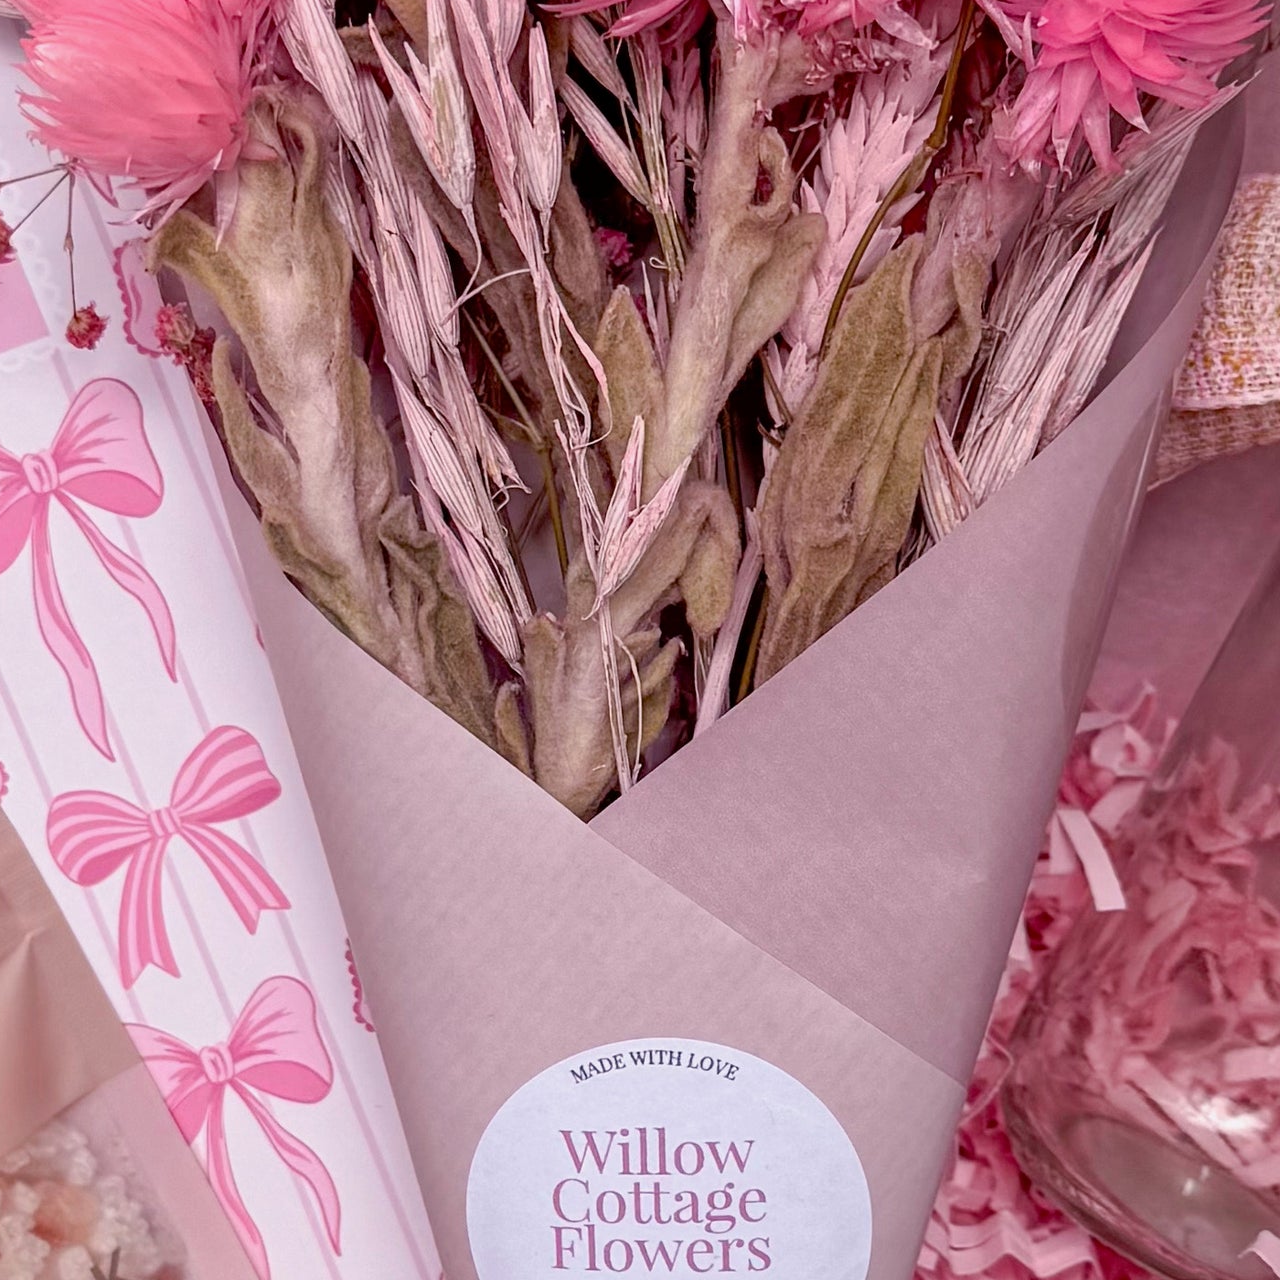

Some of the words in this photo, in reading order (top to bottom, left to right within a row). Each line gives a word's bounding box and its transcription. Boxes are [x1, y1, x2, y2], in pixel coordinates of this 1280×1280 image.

[570, 1053, 626, 1084] MADE
[628, 1049, 682, 1067] WITH
[687, 1053, 740, 1081] LOVE
[559, 1127, 755, 1175] Willow
[552, 1178, 767, 1234] Cottage
[550, 1224, 771, 1272] Flowers
